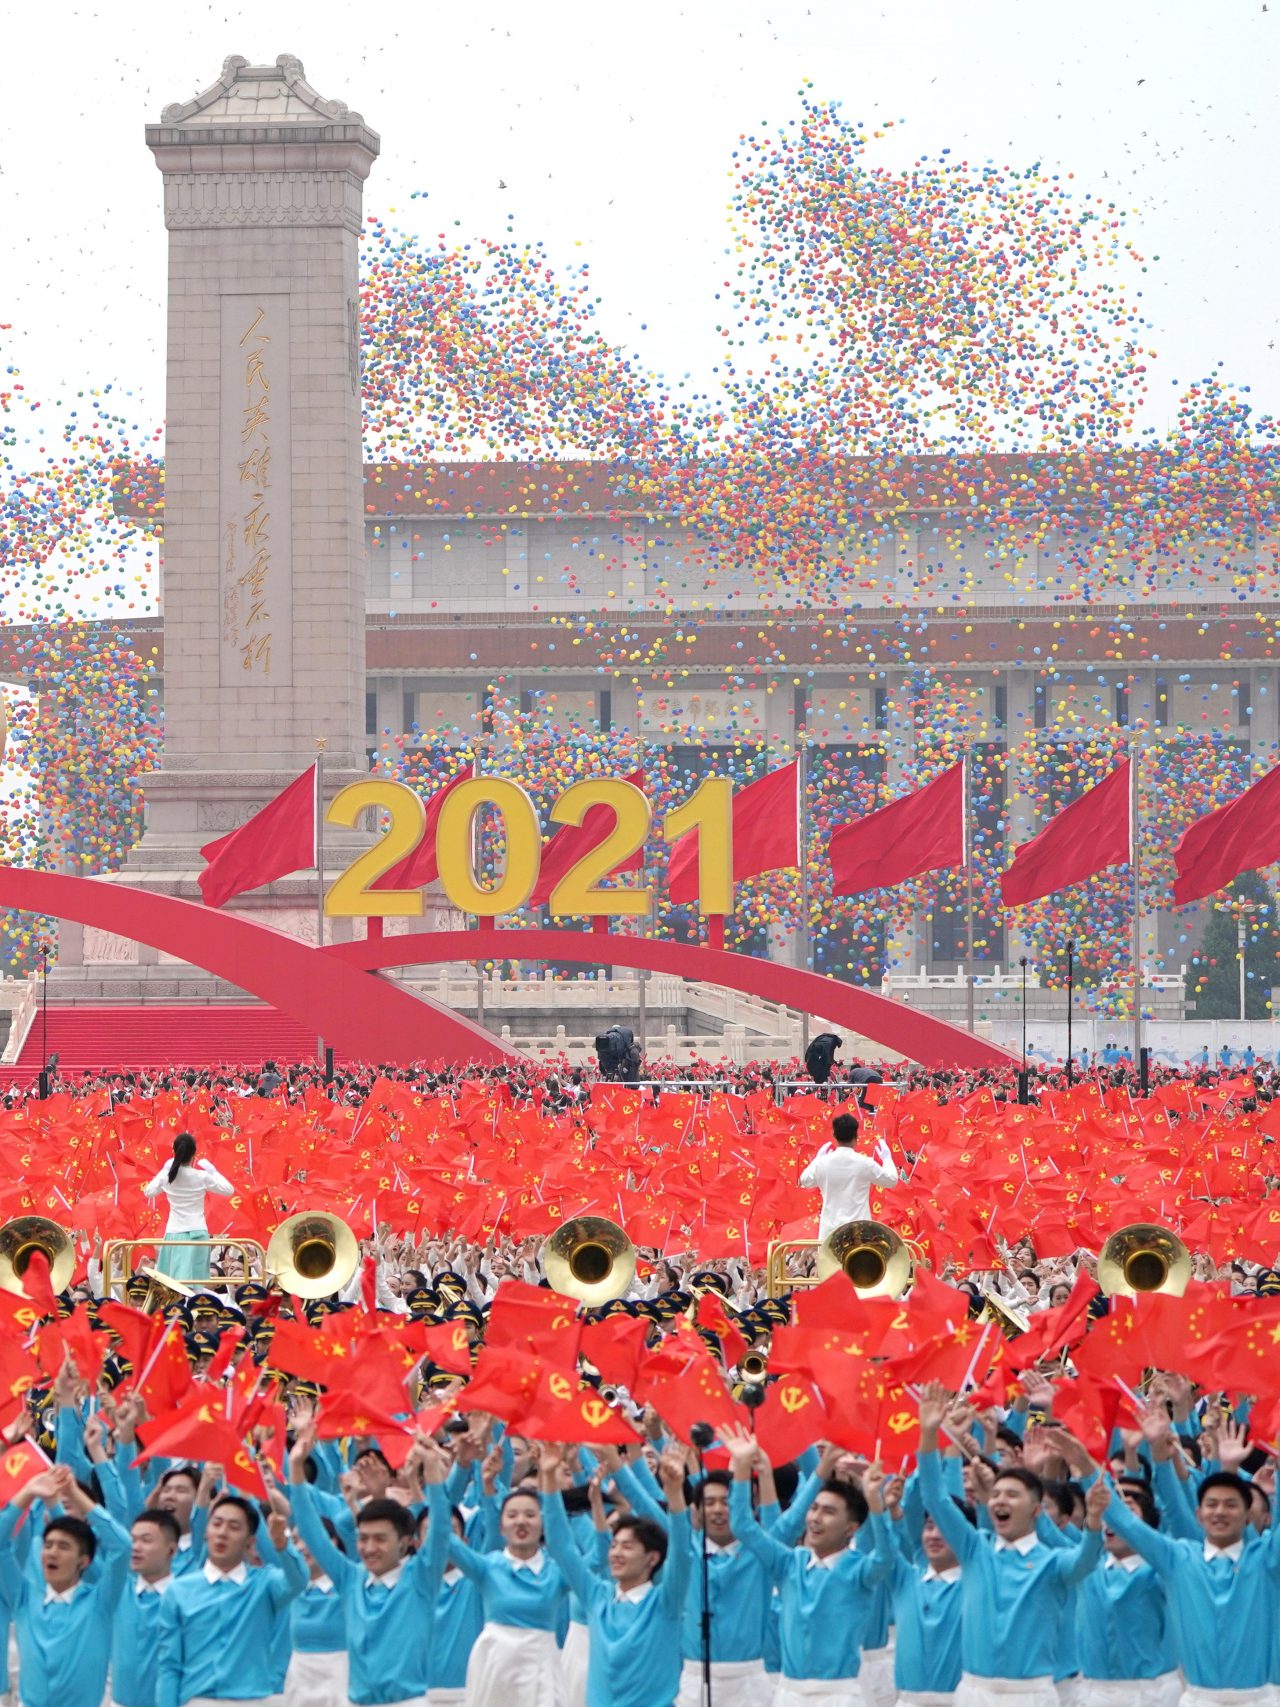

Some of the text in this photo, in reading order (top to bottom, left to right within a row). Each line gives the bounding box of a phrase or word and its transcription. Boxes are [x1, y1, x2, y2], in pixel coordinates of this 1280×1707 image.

[239, 306, 272, 675] 人民英雄永垂不朽
[324, 777, 733, 917] 2021
